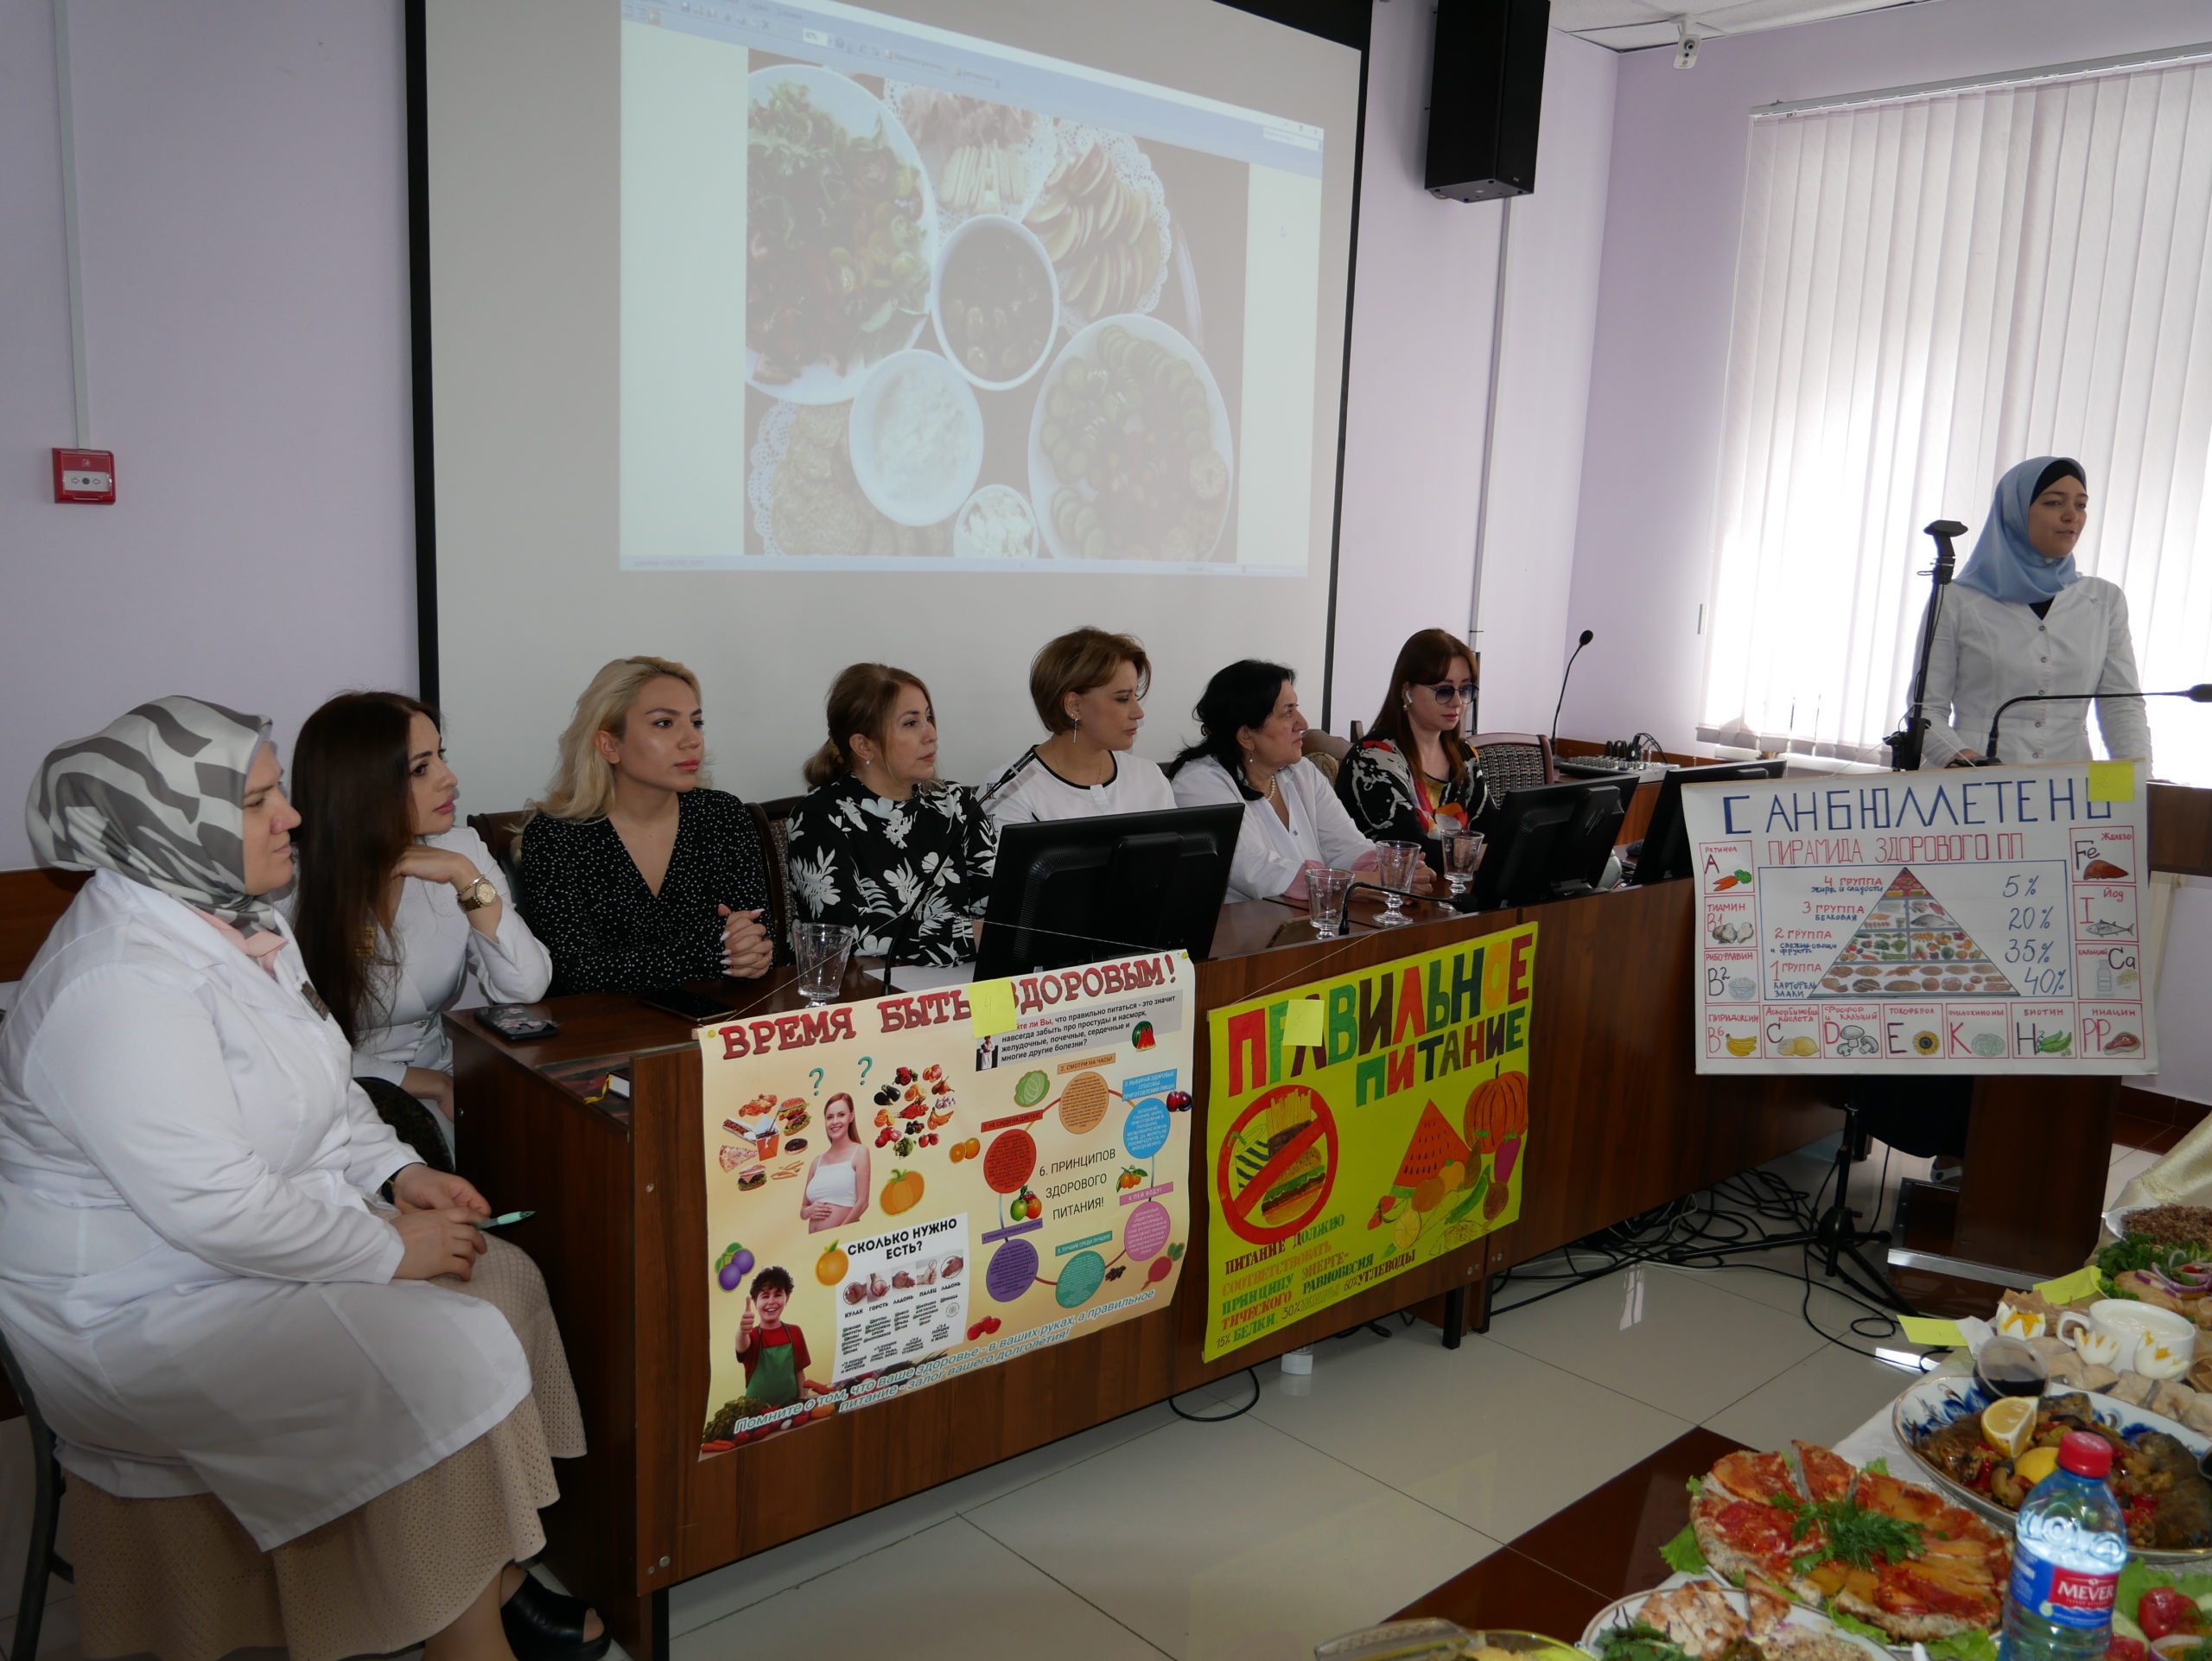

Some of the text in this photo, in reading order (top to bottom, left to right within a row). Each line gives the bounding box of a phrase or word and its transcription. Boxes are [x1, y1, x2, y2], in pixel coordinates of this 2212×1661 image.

[1768, 832, 2024, 865] ПИРАМИДА ЗДОРОВОГО ПП
[2075, 840, 2101, 870] Fe
[1840, 877, 1883, 887] ГРУППА
[1707, 903, 1745, 912] ТИАМИН
[1802, 901, 1865, 914] 3 ГРУППА
[2009, 906, 2053, 931] 20%
[1775, 927, 1832, 939] 2 ГРУППА
[2005, 939, 2054, 964] 35%
[1770, 960, 1822, 981] 1 ГРУППА
[2024, 967, 2066, 996] 40%
[718, 1007, 857, 1060] ВРЕМЯ
[877, 990, 971, 1033] БЫТЬ
[1001, 1030, 1034, 1043] навсегда
[1036, 1026, 1062, 1037] забыть
[1064, 1023, 1077, 1034] про
[1077, 1016, 1111, 1030] простуды
[1118, 1009, 1147, 1021] насморк,
[1039, 1018, 1053, 1027] Вы,
[1055, 1015, 1067, 1023] что
[1069, 1009, 1106, 1021] правильно
[1107, 1002, 1137, 1015] питаться
[1142, 1000, 1154, 1009] это
[1154, 996, 1176, 1006] значит
[1001, 1039, 1048, 1053] желудочные,
[1050, 1031, 1086, 1044] почечные,
[1087, 1023, 1124, 1038] сердечные
[1824, 1021, 1840, 1044] D
[1001, 1039, 1088, 1062] многие другие болезни?
[1356, 1006, 1526, 1107] ПИТАНИЕ
[1066, 1061, 1088, 1071] СМОТРИ
[1039, 1149, 1116, 1176] 6. ПРИНЦИПОВ
[1046, 1174, 1108, 1200] ЗДОРОВОГО
[1052, 1197, 1104, 1220] ПИТАНИЯ!
[848, 1231, 909, 1255] СКОЛЬКО
[912, 1219, 957, 1239] НУЖНО
[886, 1241, 923, 1260] ЕСТЬ?
[1225, 1213, 1344, 1276] ПИТАНИЕ ДОЛЖНО
[845, 1282, 961, 1318] КУЛАК ГОРСТЬ ЛАДОНЬ ПАЛЕЦ ЛАДОНЬ
[1222, 1253, 1374, 1331] ТИЧЕСКОГО РАВНОВЕСИЯ
[1222, 1273, 1294, 1316] ПРИНЦИПУ
[1233, 1313, 1275, 1342] БЕЛКИ
[1357, 1249, 1416, 1285] УГЛЕВОДЫ
[734, 1402, 802, 1433] Помните
[804, 1398, 816, 1410] о
[818, 1389, 849, 1407] том,
[850, 1379, 876, 1397] что
[878, 1368, 914, 1387] ваше
[917, 1346, 978, 1375] здоровье
[988, 1341, 997, 1352] в
[999, 1328, 1038, 1348] ваших
[1039, 1316, 1077, 1337] руках,
[1077, 1312, 1086, 1321] а
[1087, 1290, 1155, 1321] правильное
[839, 1385, 899, 1413] питание
[907, 1369, 947, 1392] залог
[947, 1353, 996, 1377] вашего
[995, 1329, 1070, 1363] долголетия!
